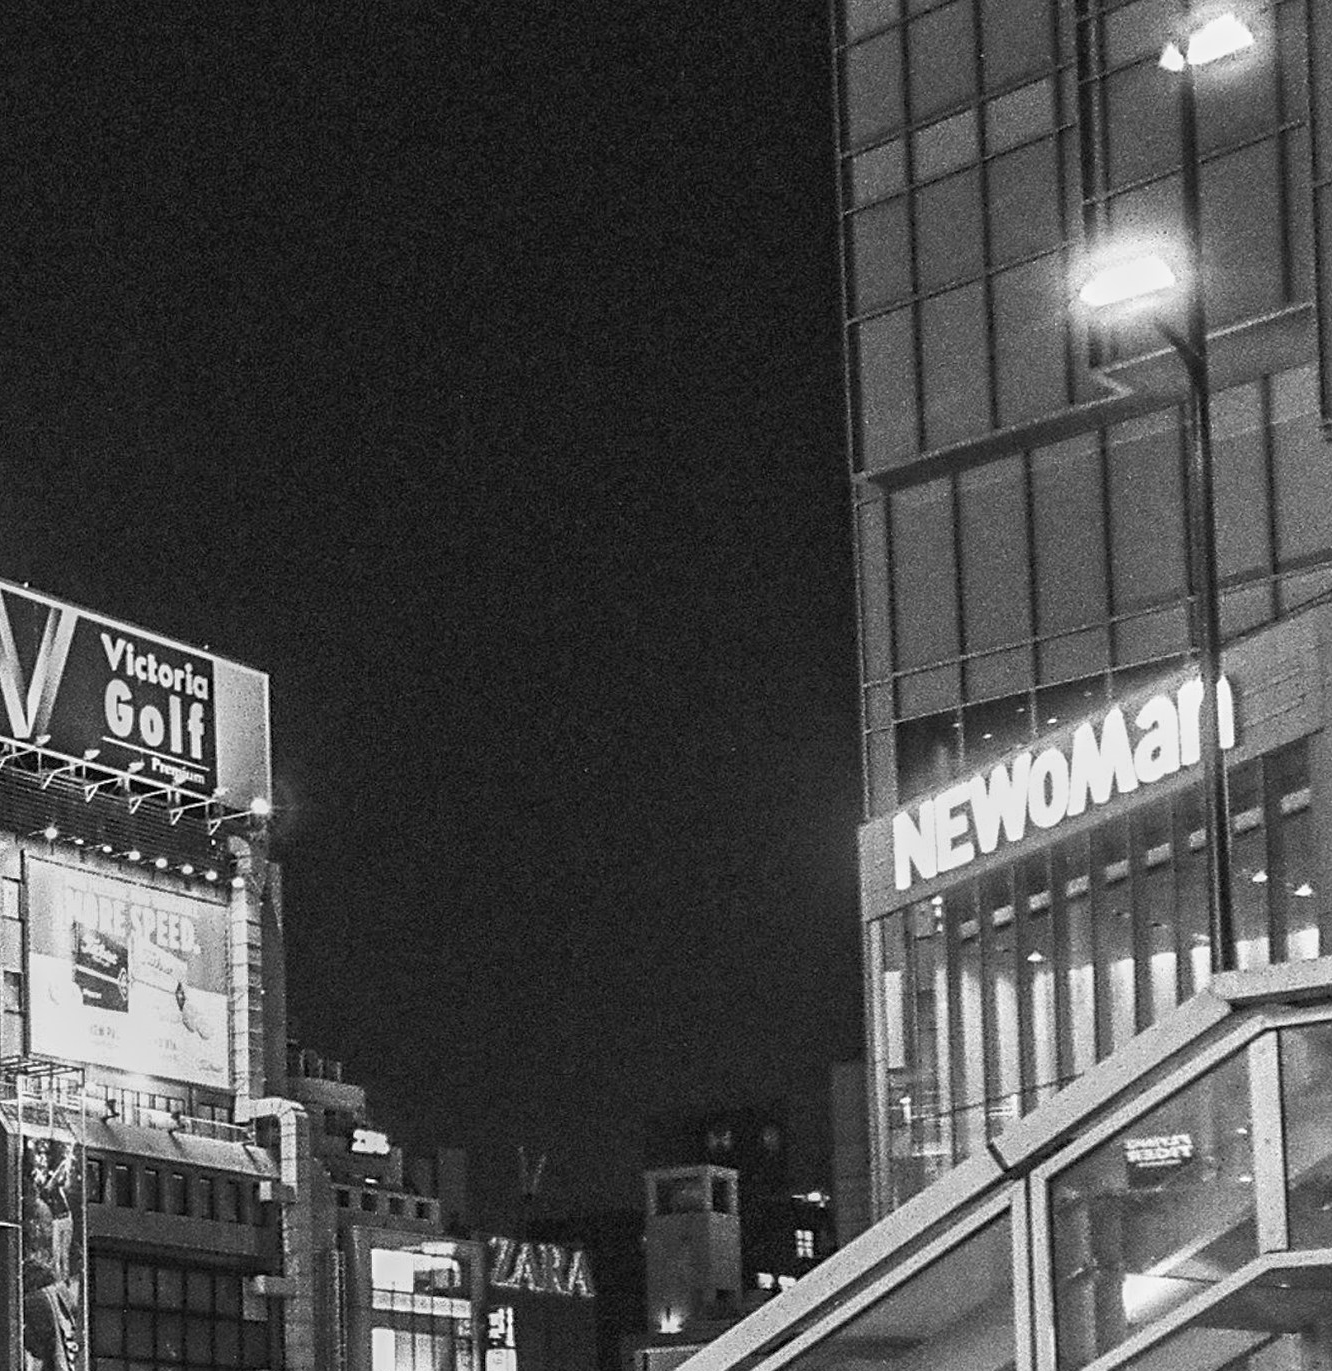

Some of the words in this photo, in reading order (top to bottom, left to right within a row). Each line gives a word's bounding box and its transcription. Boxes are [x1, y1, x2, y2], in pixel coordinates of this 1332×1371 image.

[101, 632, 209, 700] Victoria
[104, 680, 206, 760] Golf
[151, 755, 206, 785] Premium
[488, 1236, 595, 1298] ZARA
